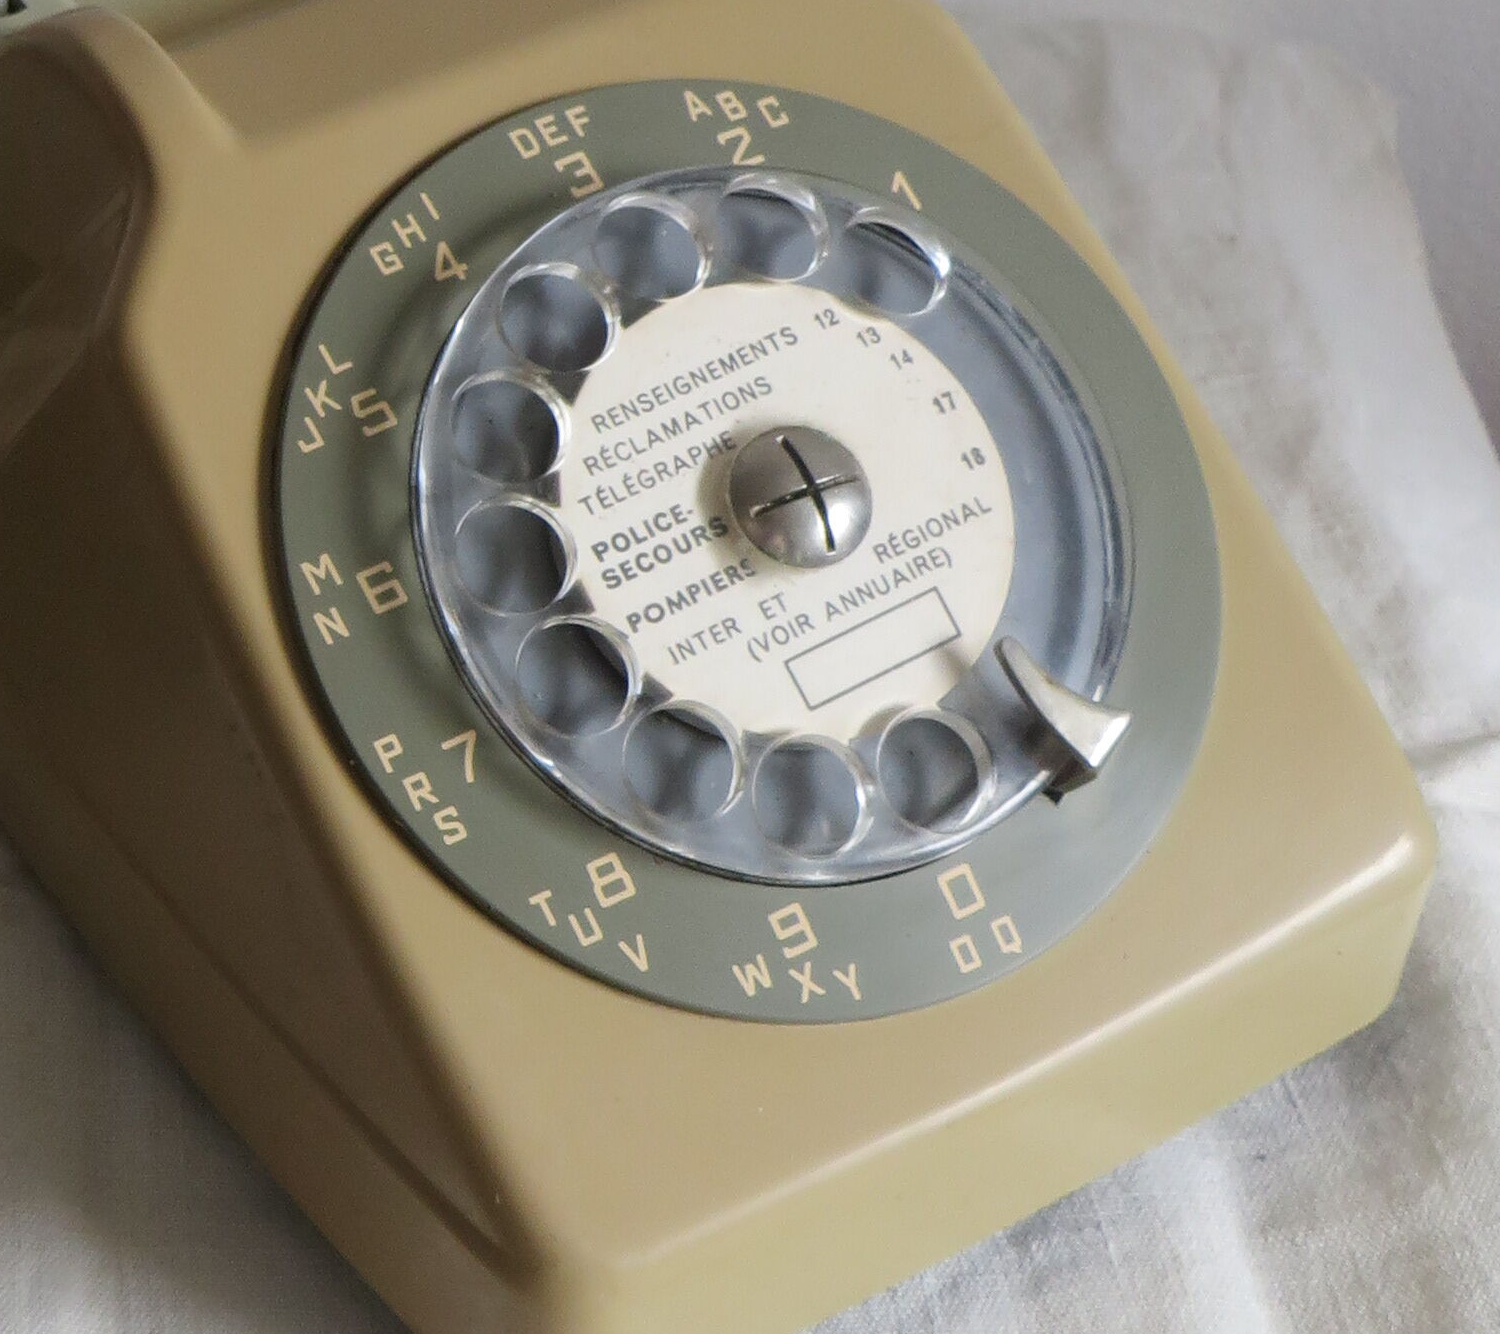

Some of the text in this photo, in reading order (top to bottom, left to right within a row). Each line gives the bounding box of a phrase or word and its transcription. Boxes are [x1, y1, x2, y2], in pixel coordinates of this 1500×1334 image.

[509, 105, 591, 158] DEF
[684, 90, 789, 127] ABC
[554, 150, 603, 198] 3
[717, 126, 766, 166] 2
[891, 170, 923, 212] 1
[370, 192, 440, 275] GHI
[433, 242, 468, 282] 4
[591, 308, 840, 434] RENSEIGNEMENTS 12
[351, 388, 398, 438] 5
[582, 327, 881, 476] RÉCLAMATIONS 13
[577, 349, 914, 516] TÉLÉGRAPHE 14
[600, 391, 957, 590] SECOURS 17
[591, 503, 694, 563] POLICE-
[626, 447, 986, 634] POMPIERS 18
[356, 561, 408, 616] 6
[667, 496, 993, 665] INTER ET RÉGIONAL
[747, 546, 954, 663] (VOIR ANNUAIRE)
[441, 731, 478, 784] 7
[586, 852, 636, 909] 8
[937, 864, 986, 919] 0
[768, 903, 818, 959] 9
